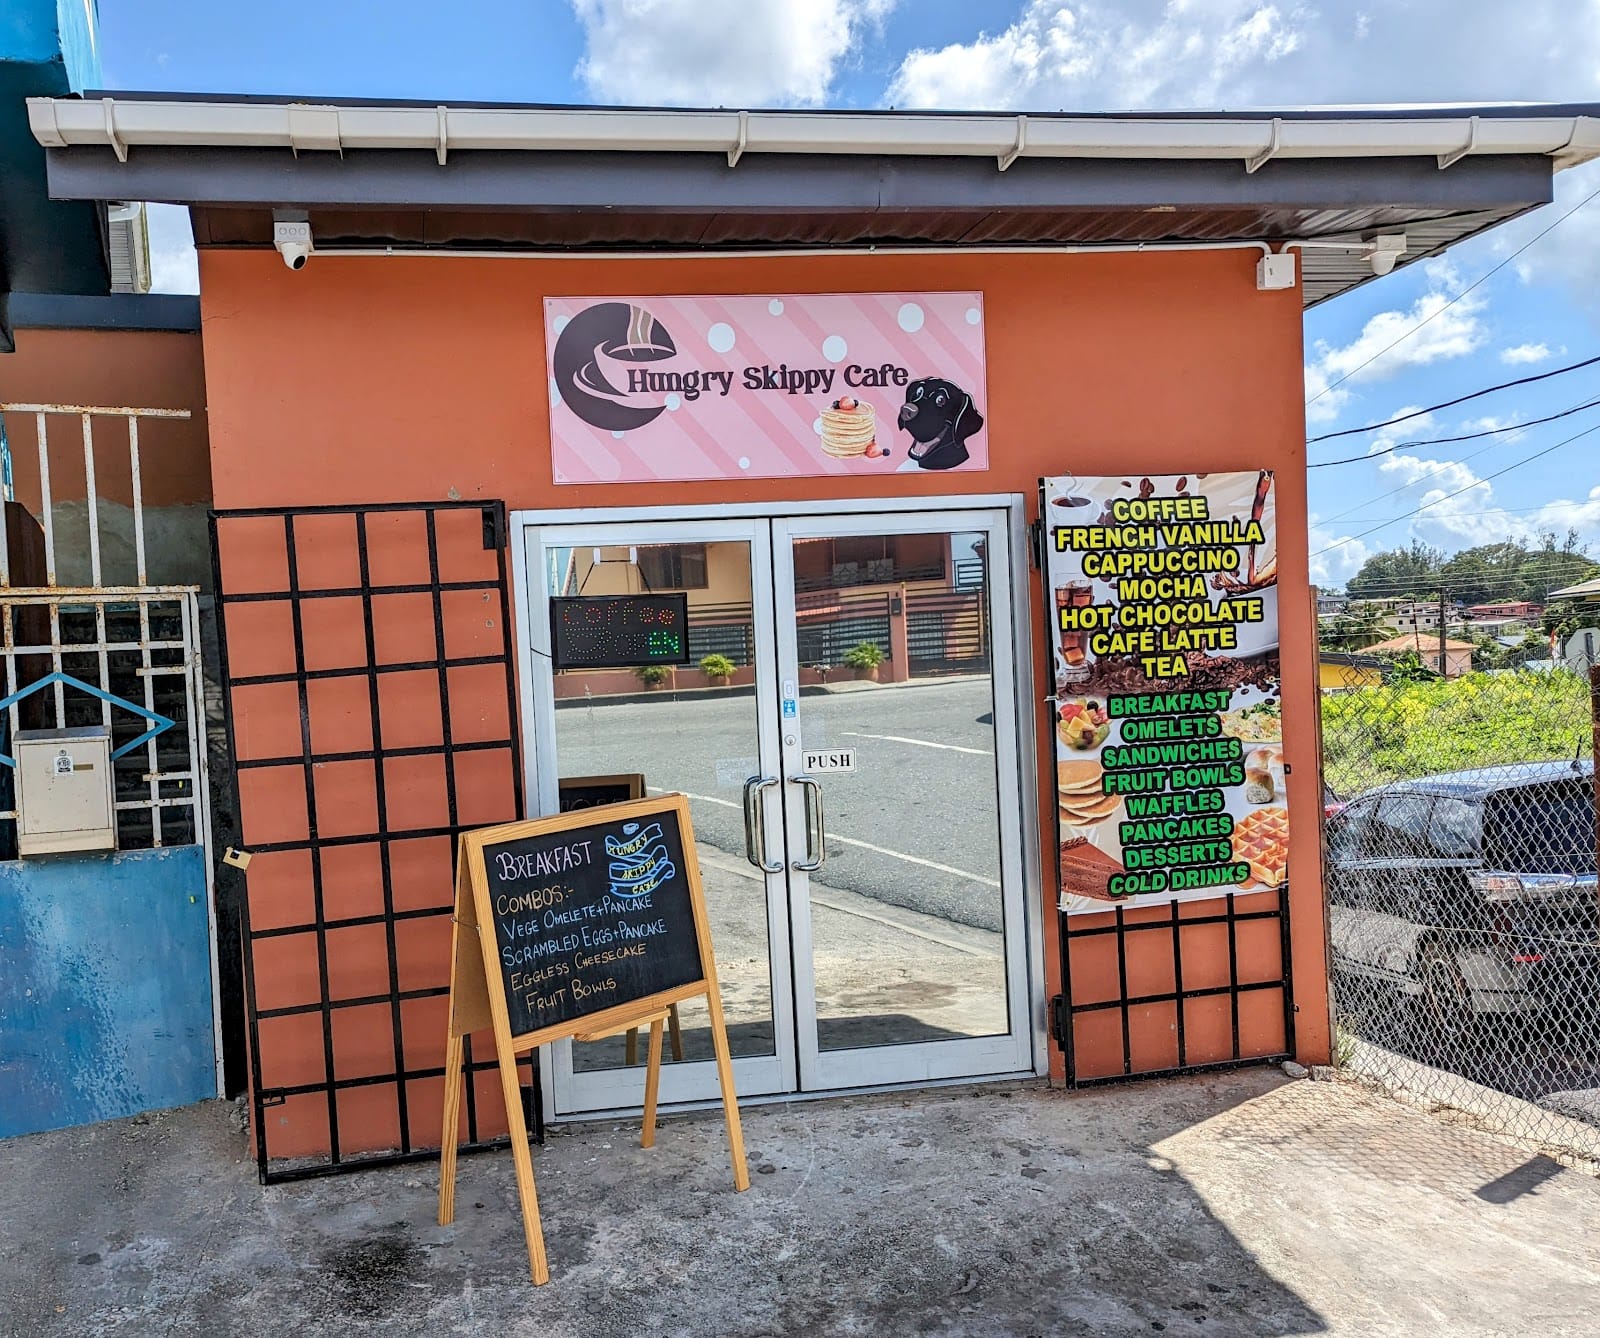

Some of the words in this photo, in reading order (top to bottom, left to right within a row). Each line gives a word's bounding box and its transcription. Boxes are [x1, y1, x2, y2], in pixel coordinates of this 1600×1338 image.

[627, 367, 734, 401] Hungry
[742, 363, 836, 396] Skippy
[843, 363, 909, 389] Cafe
[1112, 498, 1207, 522] COFFEE
[1056, 526, 1156, 550] FRENCH
[1162, 522, 1263, 546] VANILLA
[1083, 549, 1238, 576] CAPPUCCINO
[1119, 576, 1206, 600] MOCHA
[1060, 607, 1113, 630] HOT
[1120, 600, 1262, 627] CHOCOLATE
[1092, 626, 1154, 654] CAFÉ
[1162, 627, 1235, 651] LATTE
[1141, 656, 1188, 678] TEA
[1110, 691, 1230, 716] BREAKFAST
[1122, 717, 1220, 741] OMELETS
[807, 754, 851, 769] PUSH
[1103, 740, 1240, 767] SANDWICHES
[1104, 771, 1166, 793] FRUIT
[1172, 765, 1243, 788] BOWLS
[1127, 792, 1222, 816] WAFFLES
[1121, 817, 1232, 842] PANCAKES
[608, 833, 648, 856] HUNGRY
[1125, 841, 1230, 868] DESSERTS
[495, 841, 592, 880] BREAKFAST
[621, 857, 656, 880] SKIPPY
[1110, 875, 1166, 894] COLD
[1172, 864, 1248, 888] DRINKS
[502, 919, 540, 940] VEGE
[502, 934, 579, 967] SCRAMBLED
[511, 962, 570, 991] EGGLESS
[574, 943, 647, 969] CHEESECAKE
[525, 988, 567, 1014] FRUIT
[571, 978, 617, 1001] BOWLS
